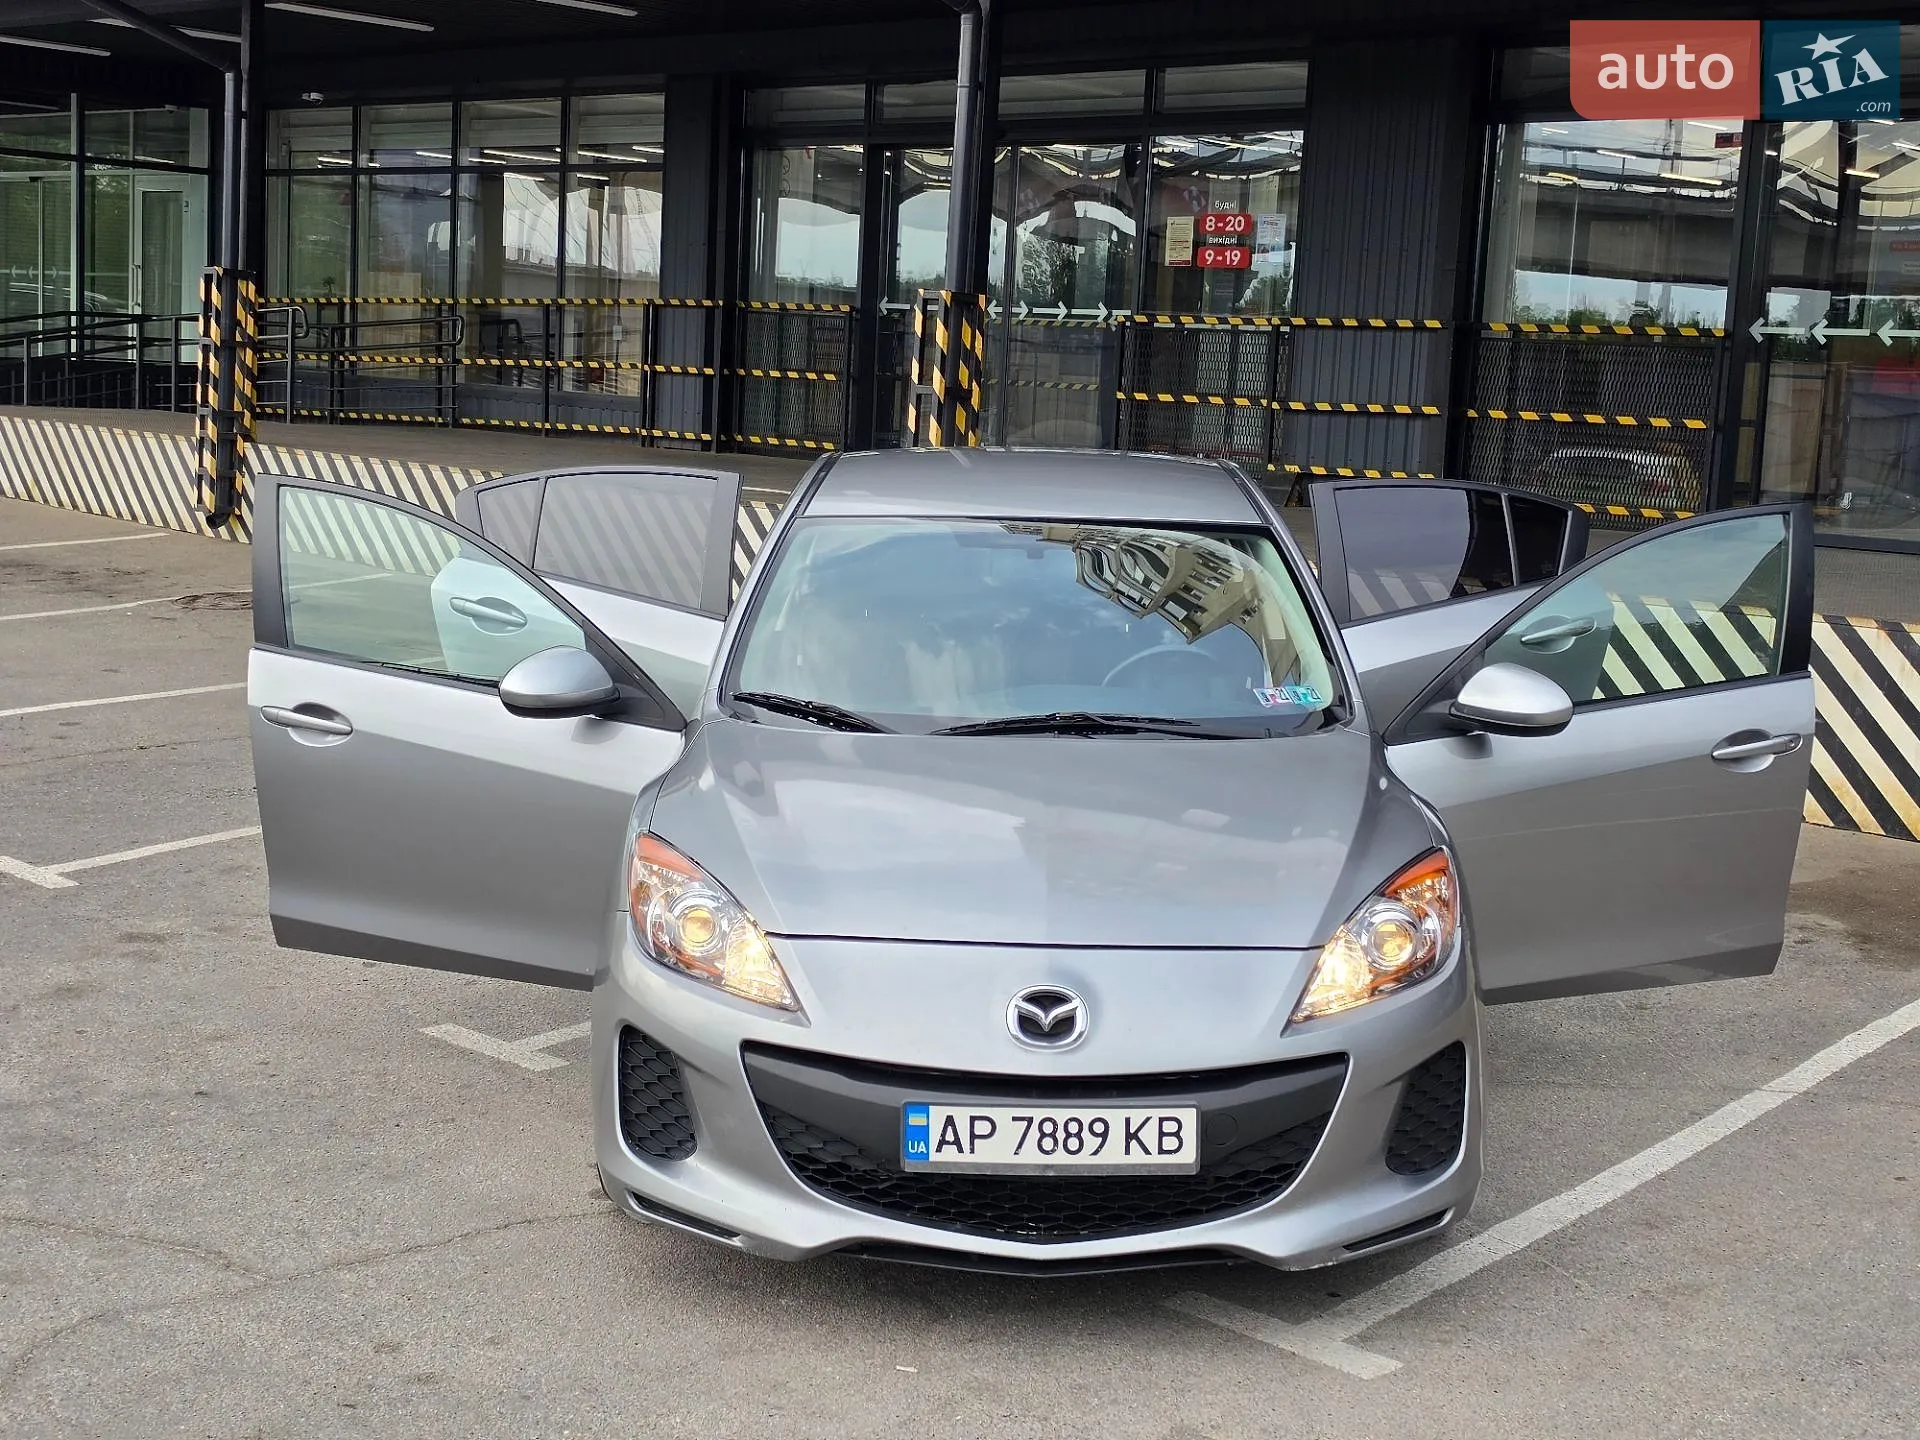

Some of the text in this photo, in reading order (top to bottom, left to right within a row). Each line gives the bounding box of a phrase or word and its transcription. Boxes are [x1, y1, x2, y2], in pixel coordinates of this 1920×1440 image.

[1214, 200, 1237, 211] будні
[1208, 235, 1238, 245] вихідні
[935, 1114, 1184, 1157] AP 7889 KB
[908, 1140, 928, 1155] UA
